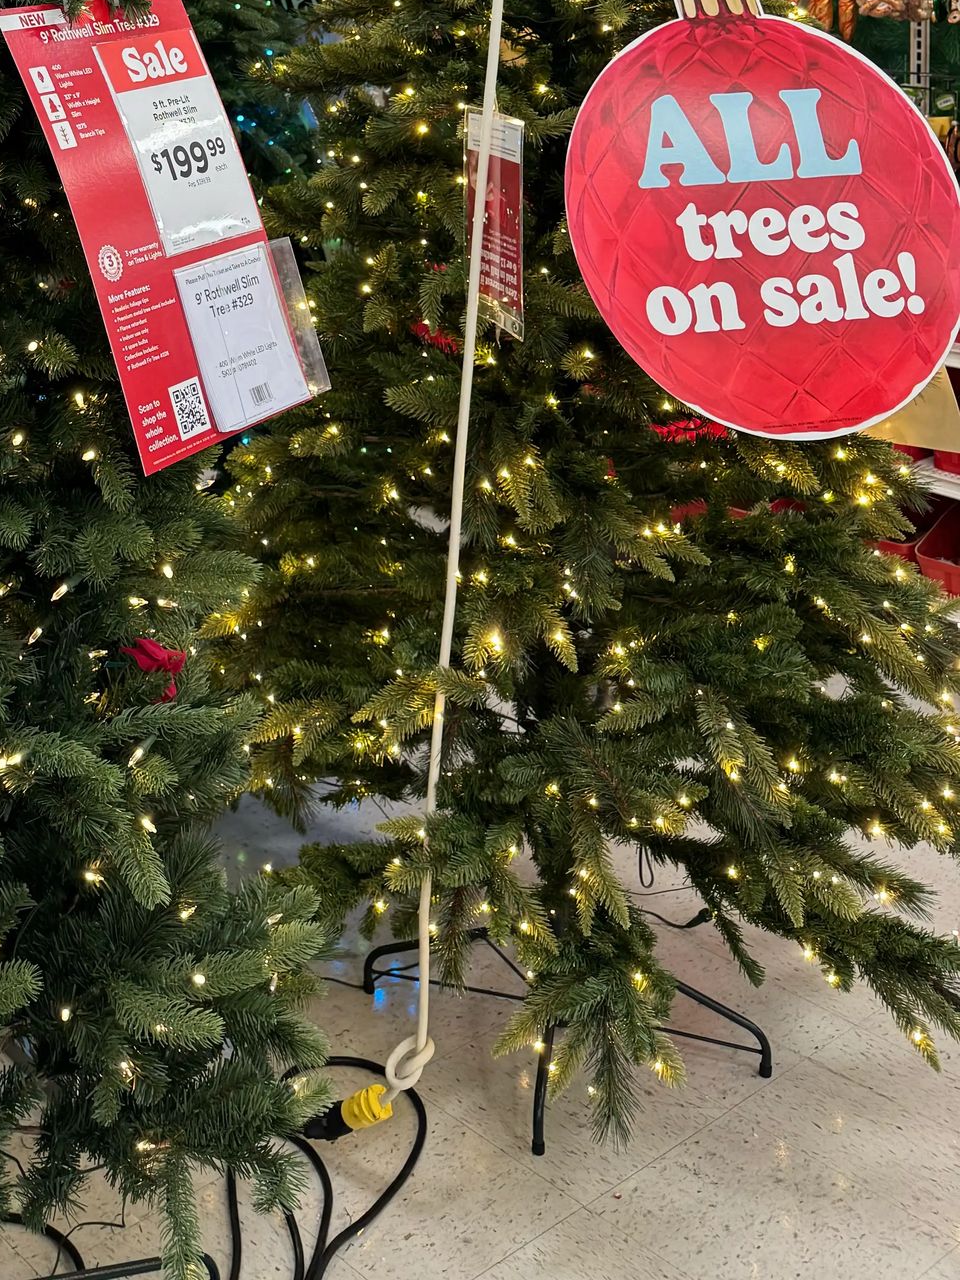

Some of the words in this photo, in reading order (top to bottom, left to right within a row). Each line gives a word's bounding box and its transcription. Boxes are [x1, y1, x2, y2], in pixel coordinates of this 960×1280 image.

[18, 13, 46, 28] NEW
[40, 30, 49, 44] 9'
[51, 26, 94, 43] Rothwell
[94, 21, 116, 35] Slim
[113, 18, 136, 31] Tree
[121, 40, 188, 83] Sale
[69, 70, 83, 78] White
[83, 68, 93, 76] LED
[58, 81, 74, 89] Lights
[67, 101, 83, 109] Width
[85, 97, 101, 106] Height
[152, 101, 159, 110] 9
[158, 99, 168, 108] ft.
[167, 94, 191, 107] Pre-Lit
[152, 107, 182, 122] Rothwell
[182, 105, 198, 115] Slim
[79, 130, 96, 139] Branch
[95, 128, 106, 136] Tips
[638, 88, 863, 189] ALL
[676, 201, 866, 262] trees
[139, 242, 159, 253] warranty
[134, 255, 145, 265] Tree
[148, 250, 163, 260] Lights
[108, 292, 124, 304] More
[124, 284, 151, 298] Features:
[194, 292, 203, 305] 9'
[204, 278, 242, 302] Rothwell
[240, 274, 260, 289] Slim
[645, 279, 746, 336] on
[760, 251, 926, 328] sale!
[209, 303, 230, 318] Tree
[231, 293, 254, 311] #329
[138, 403, 154, 414] Scan
[141, 415, 157, 427] shop
[156, 411, 167, 420] the
[145, 426, 163, 439] whole
[148, 434, 178, 452] collection.
